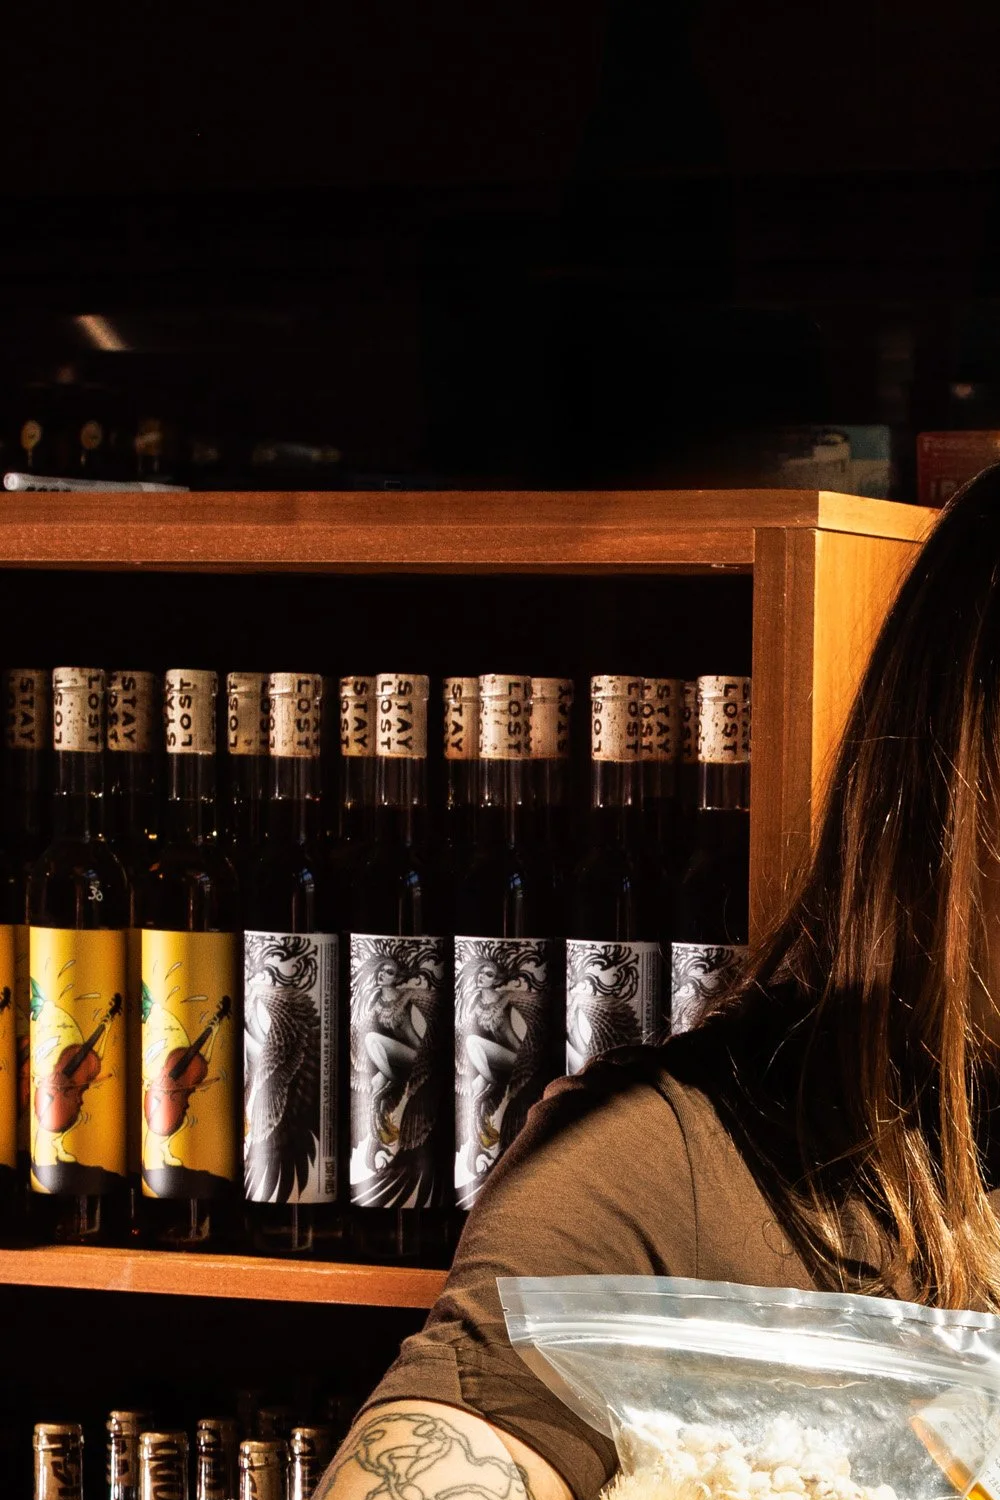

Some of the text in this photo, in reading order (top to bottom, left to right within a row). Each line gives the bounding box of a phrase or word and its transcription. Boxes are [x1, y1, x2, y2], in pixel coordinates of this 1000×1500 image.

[88, 675, 100, 744] LOST
[121, 676, 137, 743] STAY
[179, 678, 193, 747] LOST
[229, 681, 239, 748] LOST
[296, 679, 311, 749] LOST
[353, 681, 367, 749] STAY
[380, 681, 392, 750] LOST
[396, 681, 413, 751] STAY
[451, 683, 463, 752] STAY
[508, 681, 521, 754] LOST
[626, 682, 639, 754] LOST
[656, 684, 670, 753] STAY
[723, 683, 738, 754] LOST
